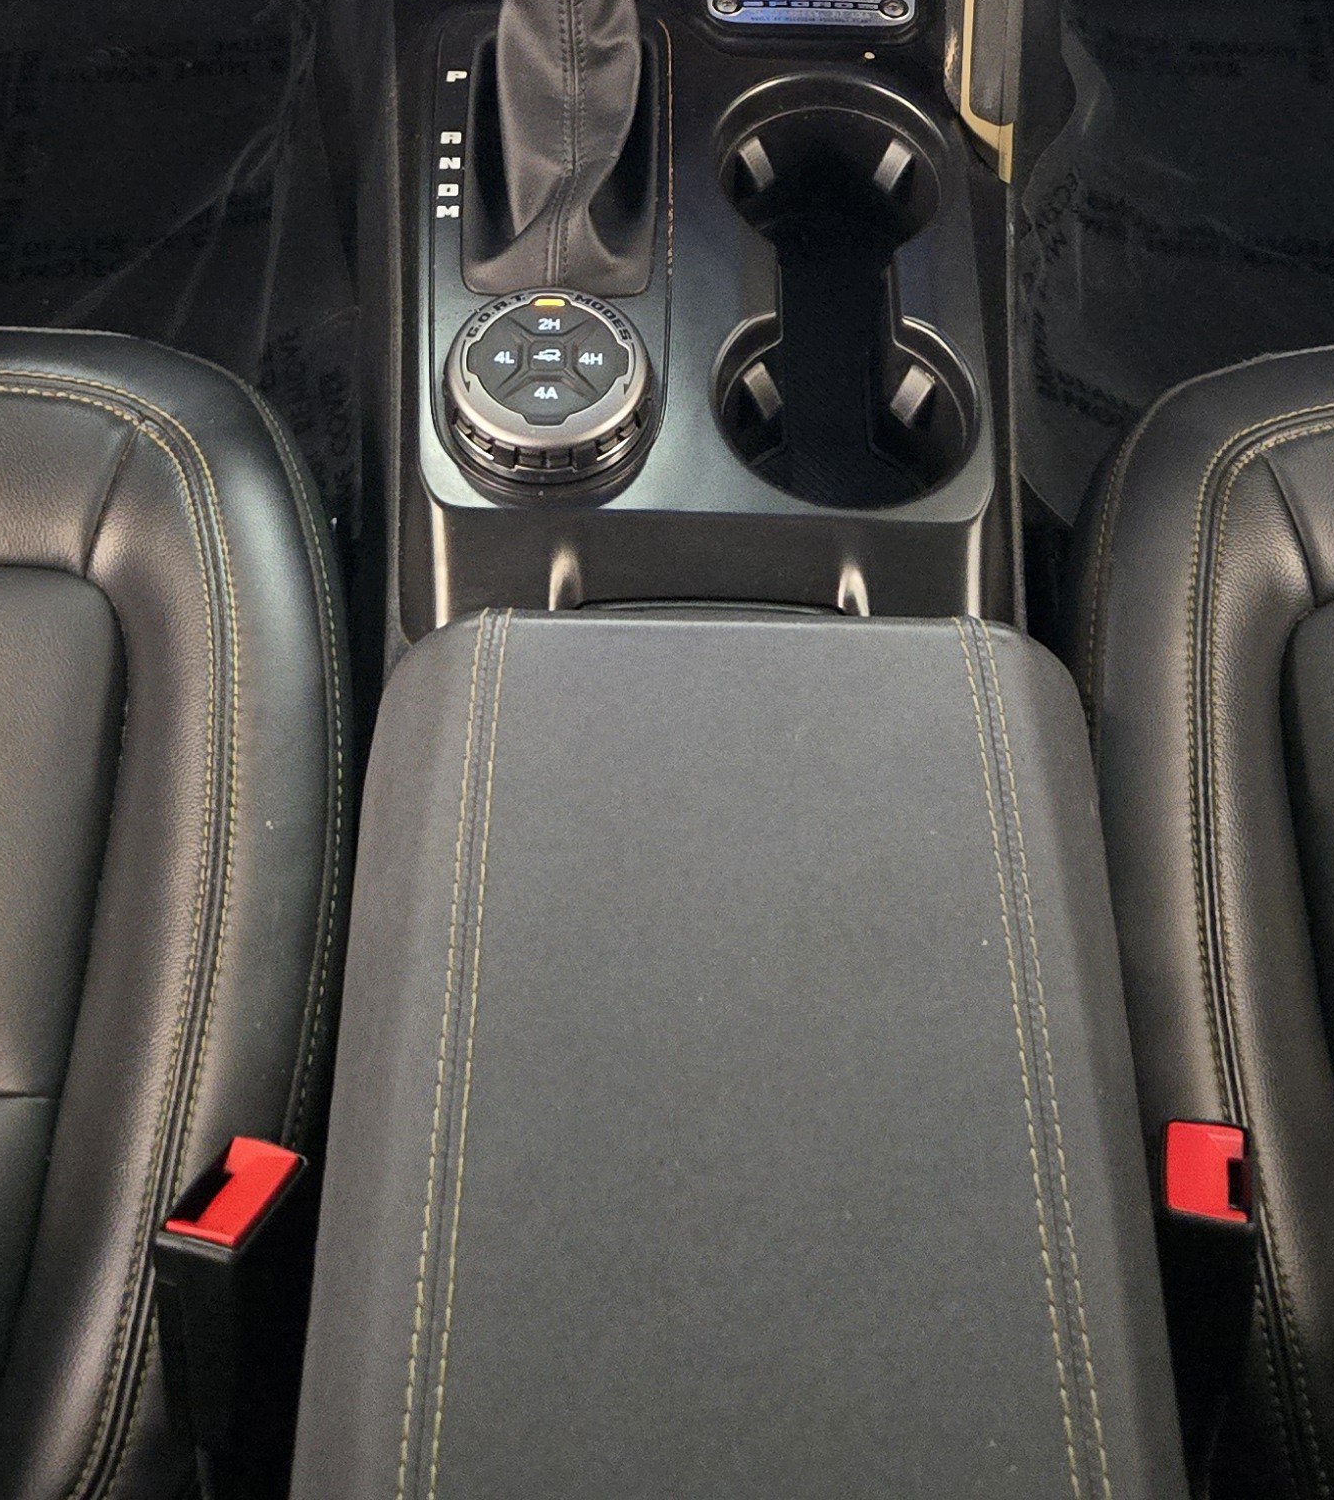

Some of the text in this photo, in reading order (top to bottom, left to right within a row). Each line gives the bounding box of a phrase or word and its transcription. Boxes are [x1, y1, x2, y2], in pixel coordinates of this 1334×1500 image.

[445, 70, 468, 83] P
[439, 157, 461, 170] N
[436, 205, 460, 219] M
[574, 294, 632, 341] MODES
[537, 318, 561, 331] 2H
[493, 351, 515, 364] 4L
[578, 352, 603, 365] 4H
[533, 386, 558, 399] 4A
